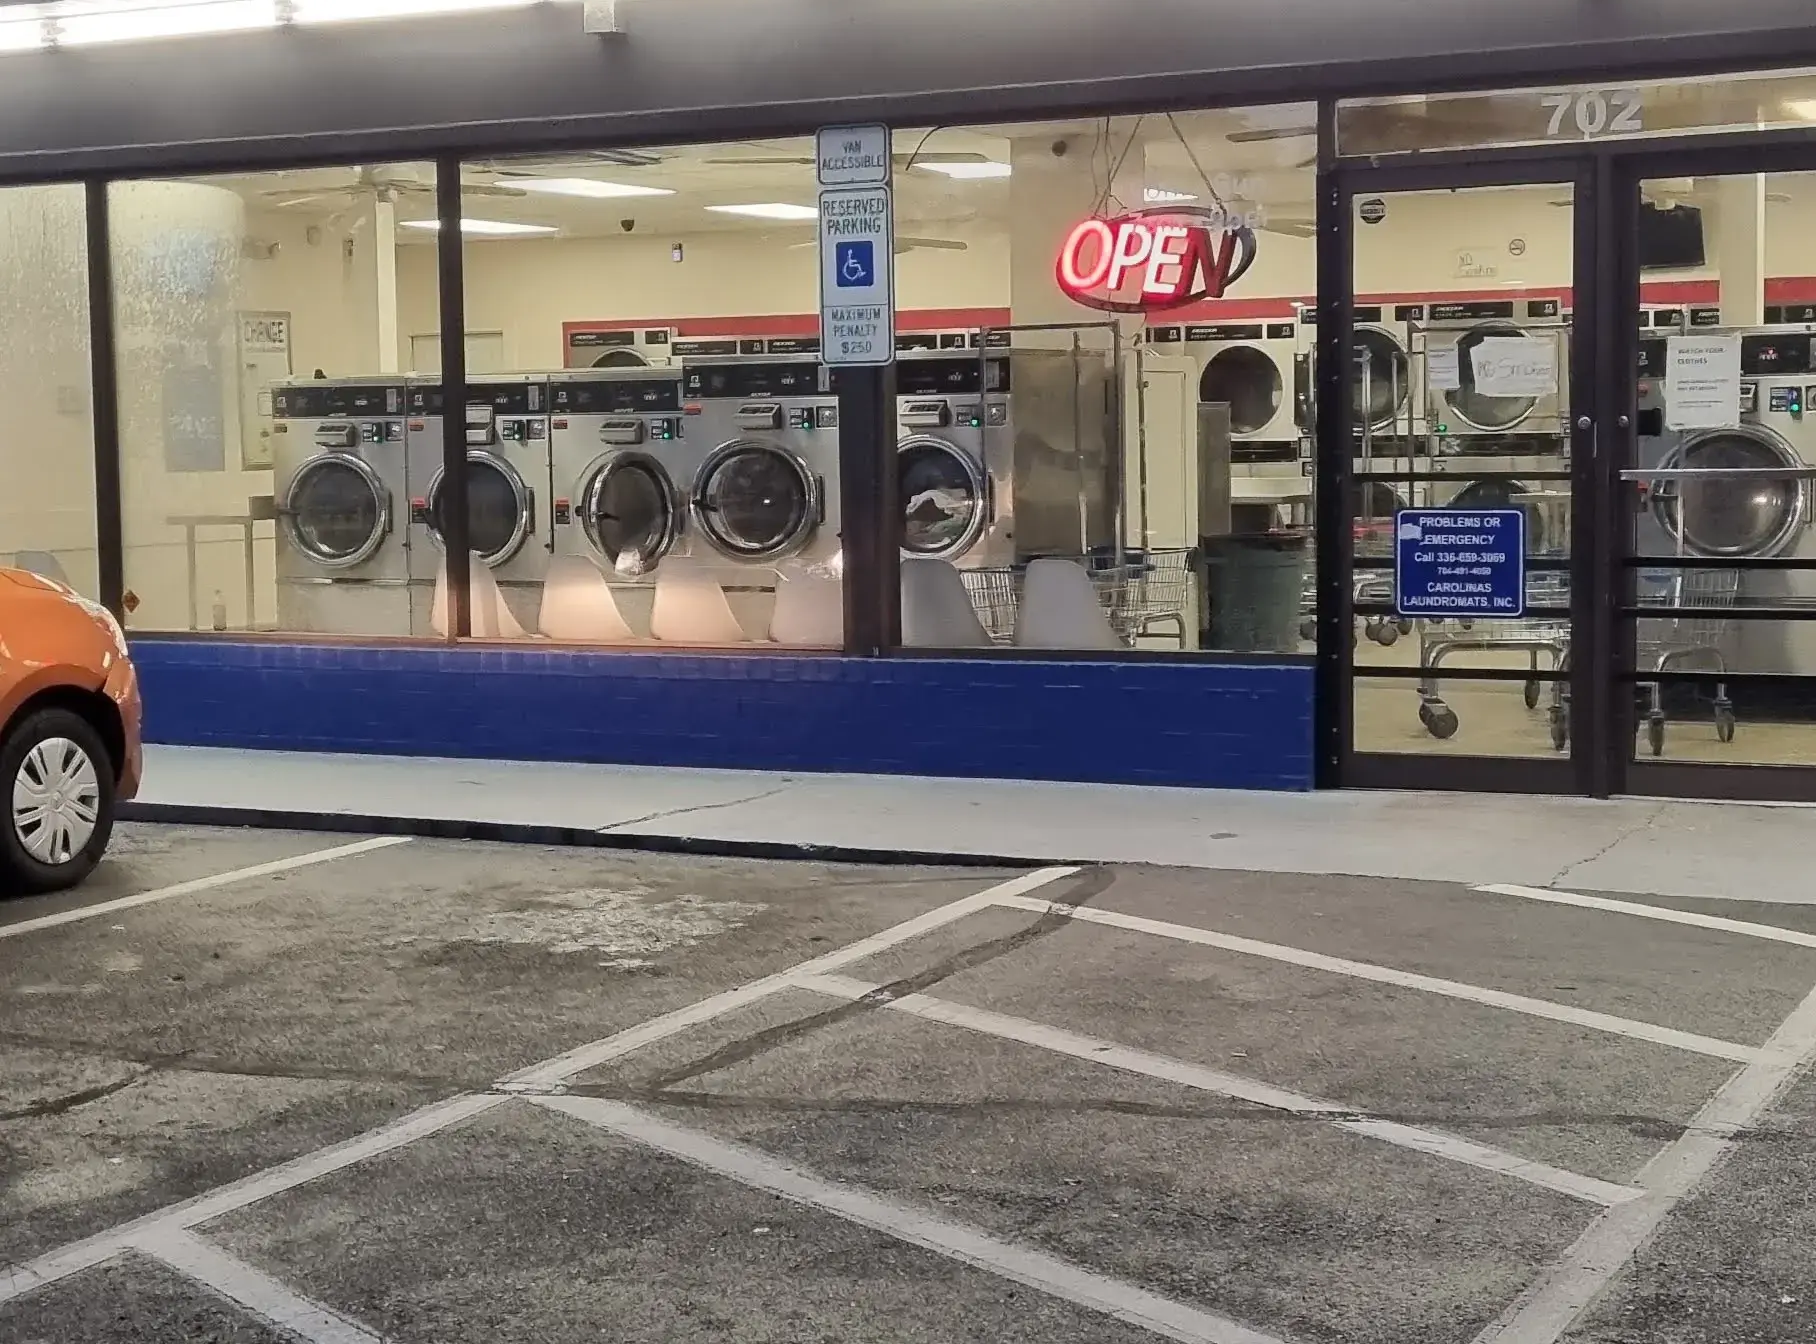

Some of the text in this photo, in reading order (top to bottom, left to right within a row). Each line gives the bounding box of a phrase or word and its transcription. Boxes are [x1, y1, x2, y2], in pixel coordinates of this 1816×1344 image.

[1541, 90, 1643, 135] 702
[842, 141, 861, 155] VAN
[822, 153, 884, 170] ACCESSIBLE
[823, 198, 885, 218] RESERVED
[827, 218, 881, 235] PARKING
[1060, 219, 1236, 299] OPEN
[832, 307, 881, 319] MAXIMUM
[834, 324, 877, 338] PENALTY
[1677, 357, 1708, 365] CLOTHES
[1420, 517, 1501, 528] PROBLEMS OR
[1424, 535, 1495, 545] EMERGENCY
[1414, 552, 1434, 562] Call
[1427, 582, 1492, 593] CAROLINAS
[1494, 597, 1516, 608] INC.
